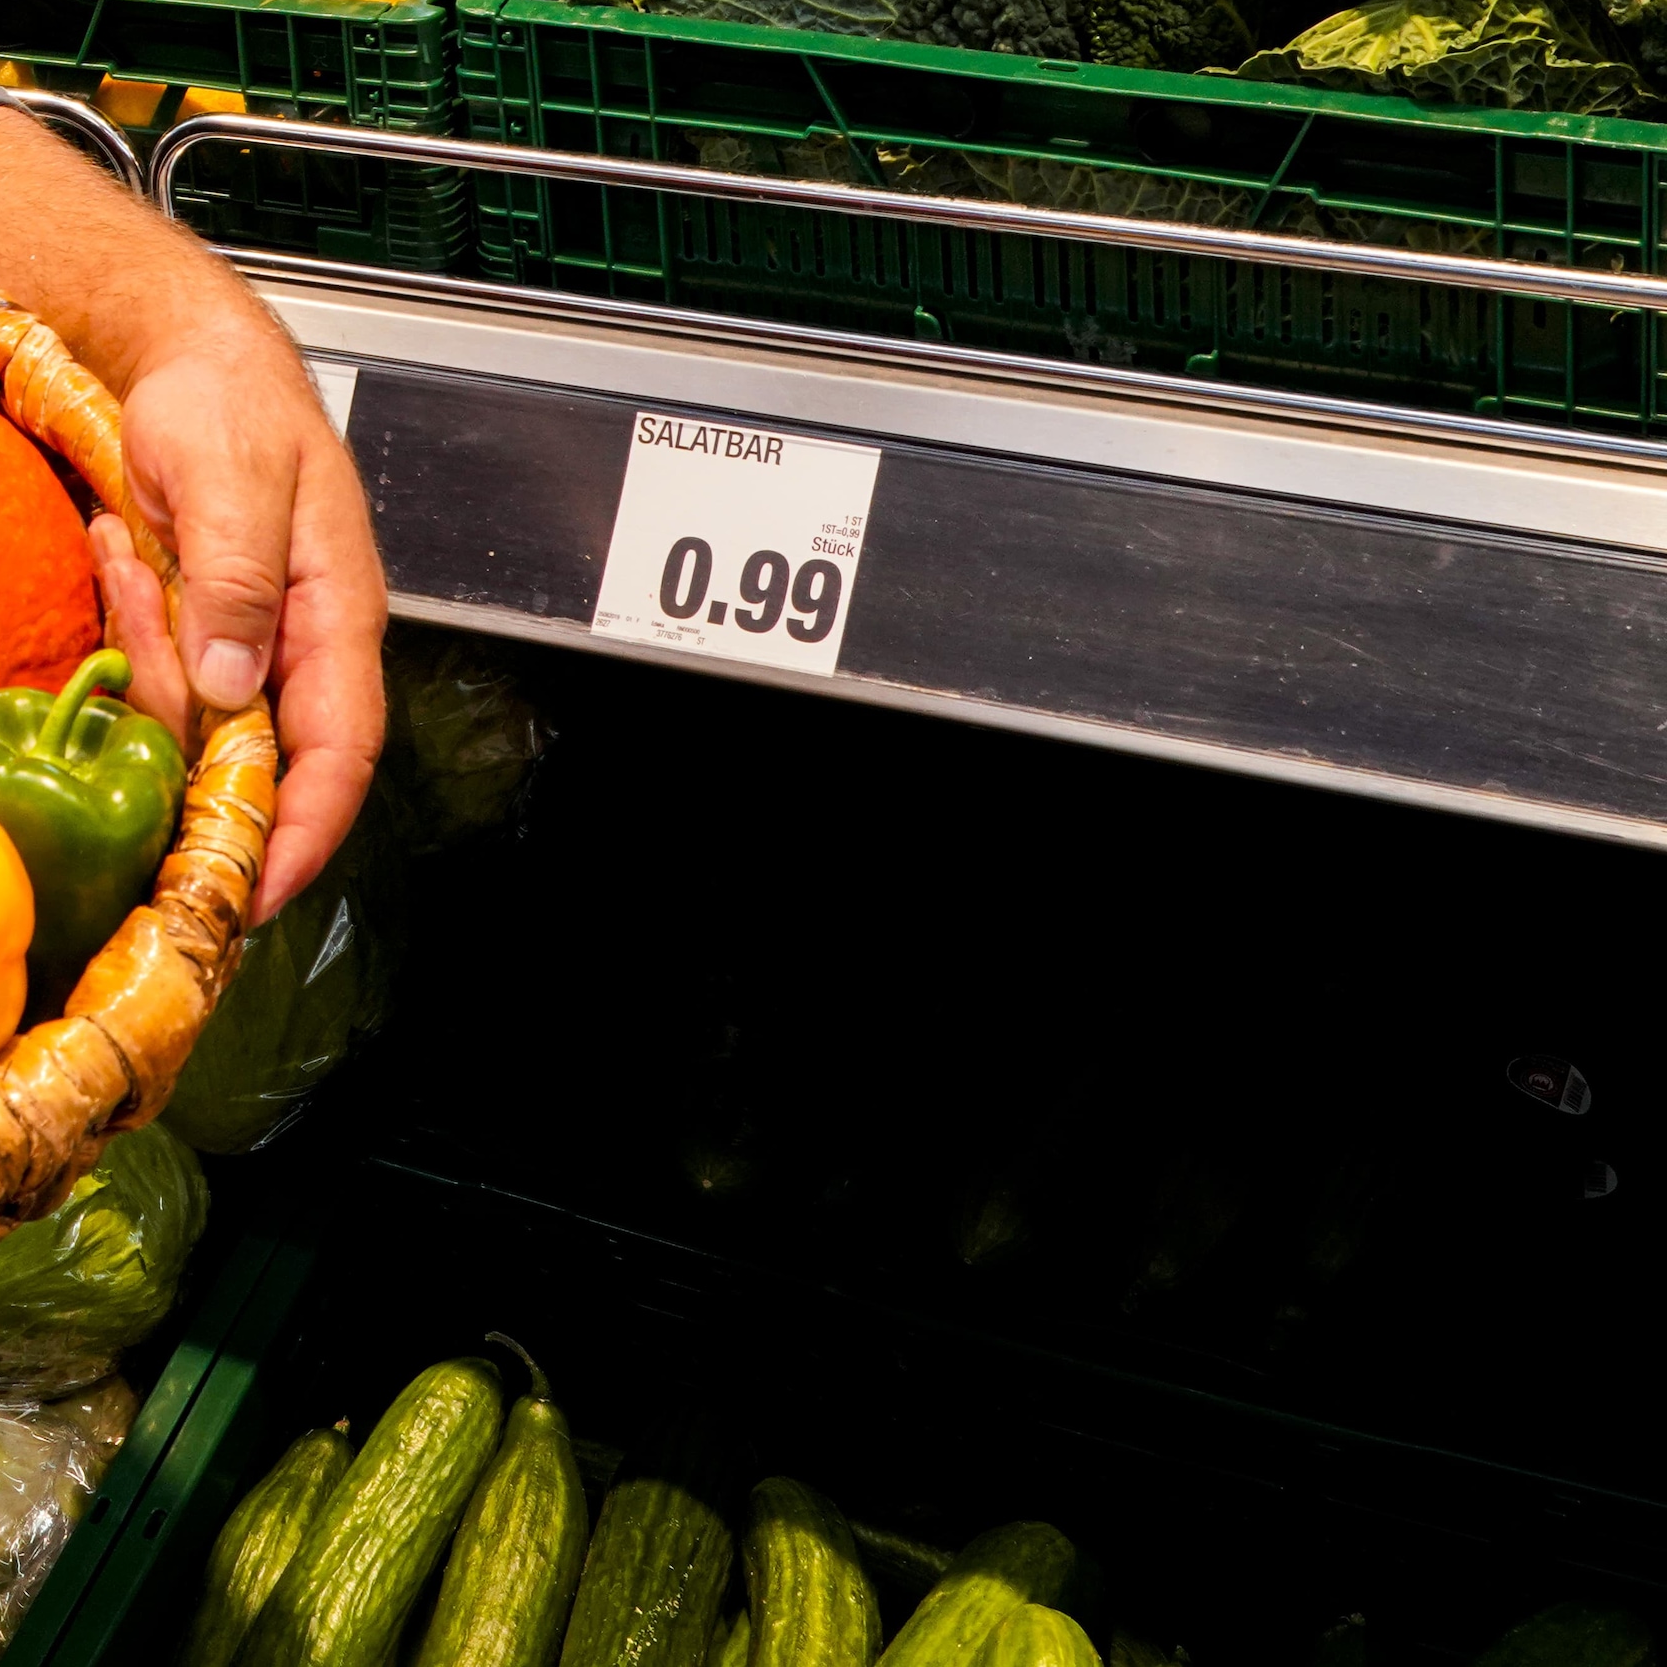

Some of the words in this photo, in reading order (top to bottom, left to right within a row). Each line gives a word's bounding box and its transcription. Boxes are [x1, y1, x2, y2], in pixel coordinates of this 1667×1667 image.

[637, 417, 784, 466] SALATBAR
[822, 523, 860, 539] 1ST=0,99
[851, 516, 863, 526] ST
[811, 536, 856, 558] Stück
[659, 536, 842, 643] 0.99
